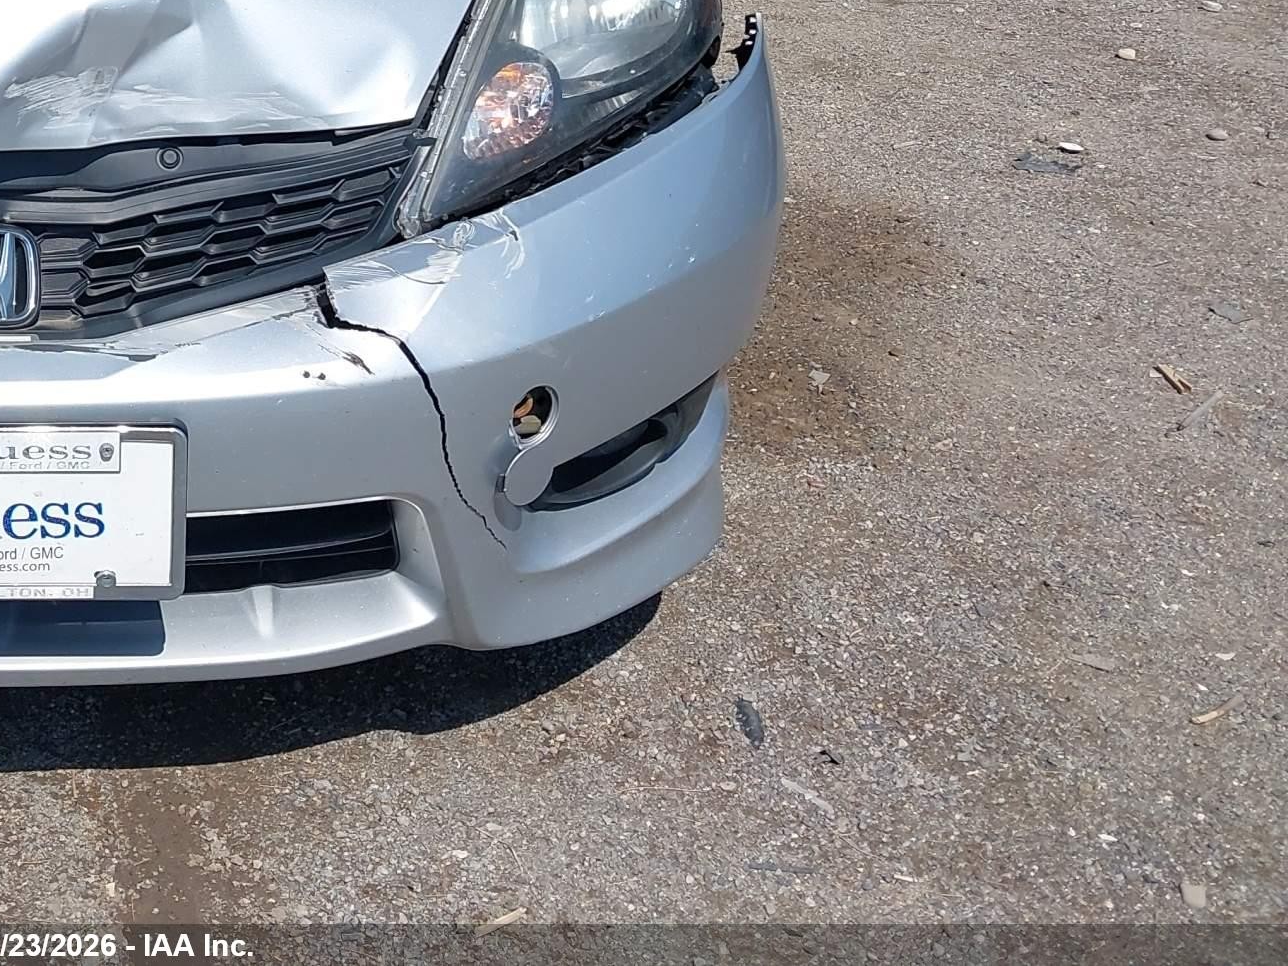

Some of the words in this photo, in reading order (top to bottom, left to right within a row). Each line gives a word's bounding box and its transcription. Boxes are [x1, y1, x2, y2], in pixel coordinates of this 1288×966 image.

[10, 461, 42, 470] Ford
[56, 461, 90, 470] GMC
[29, 546, 64, 560] GMC
[63, 587, 89, 597] OH
